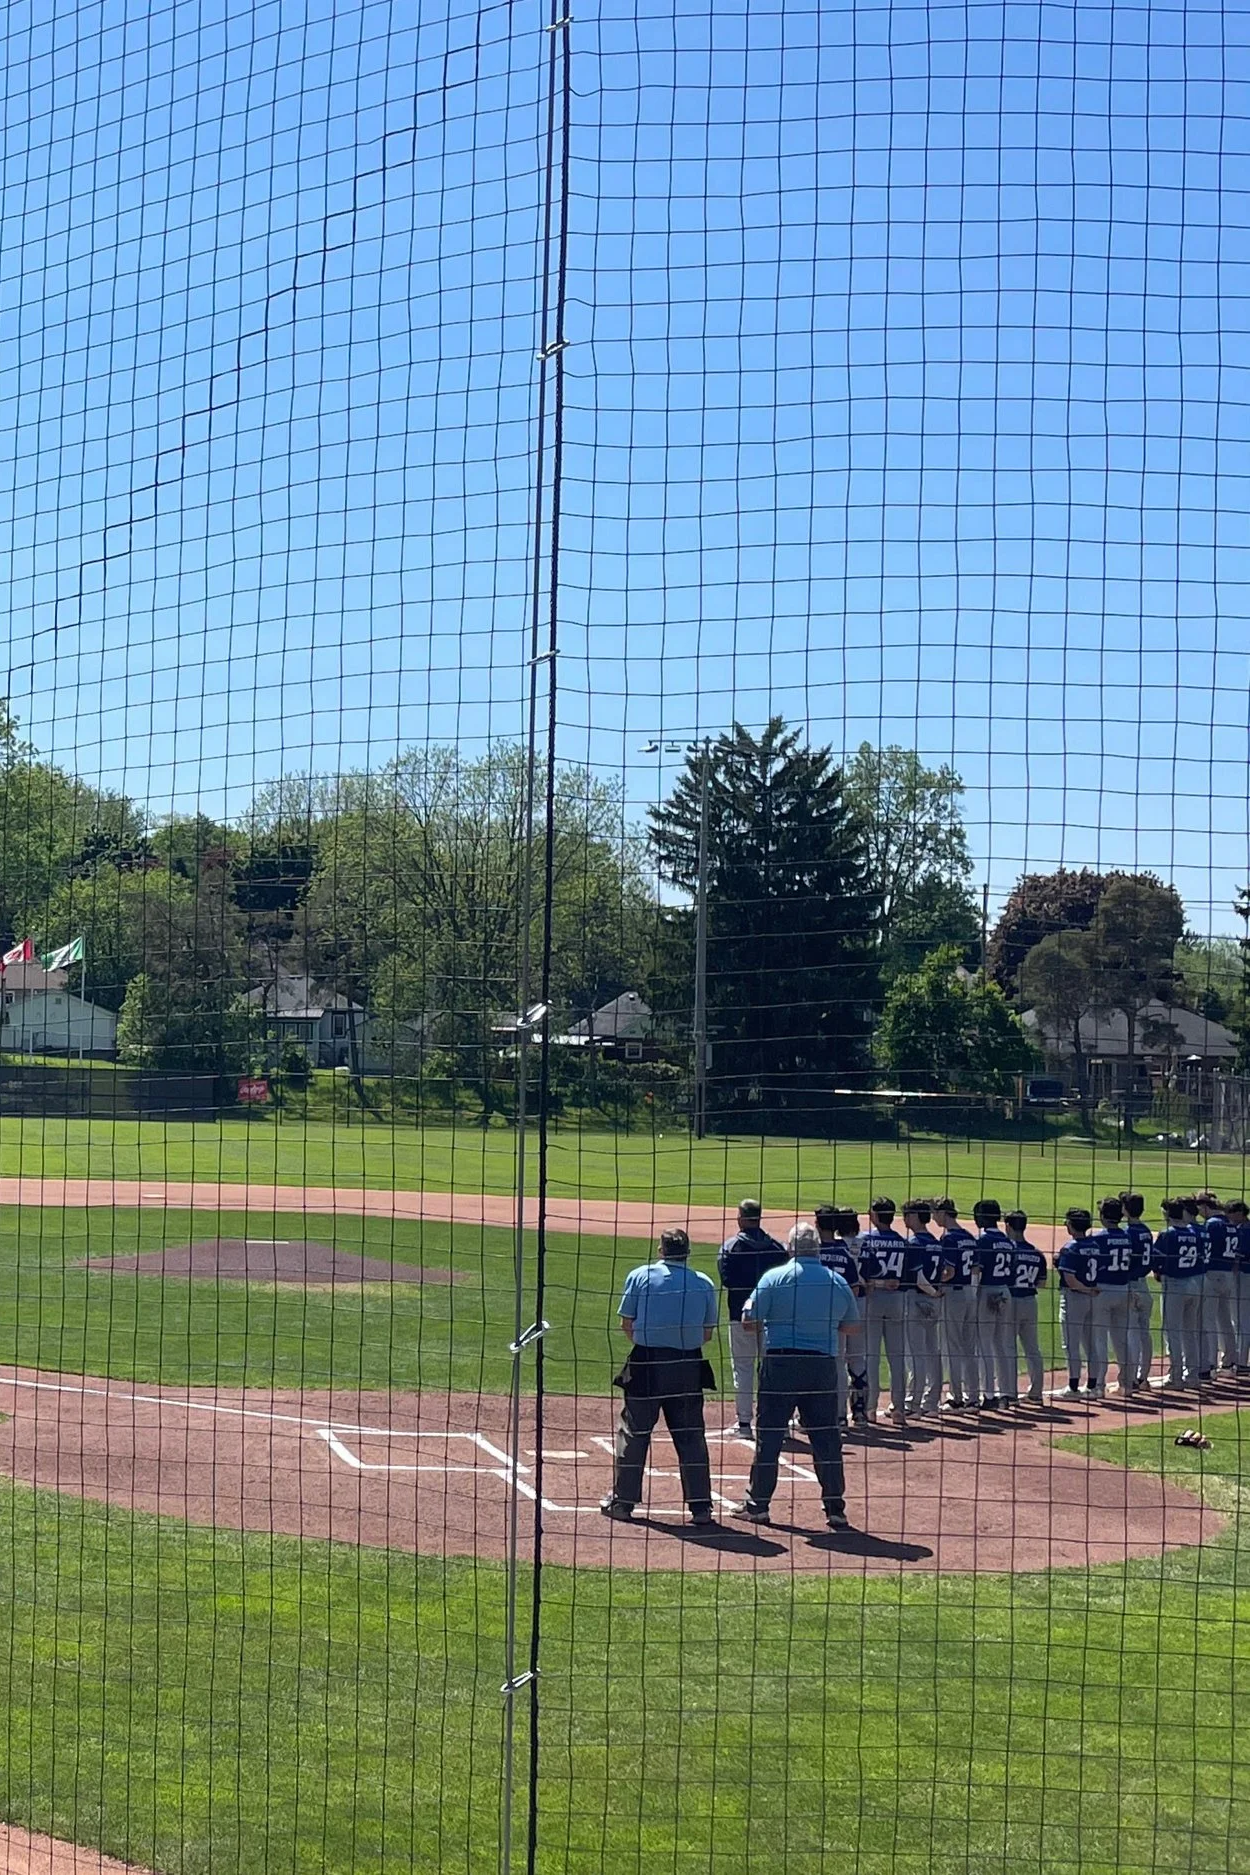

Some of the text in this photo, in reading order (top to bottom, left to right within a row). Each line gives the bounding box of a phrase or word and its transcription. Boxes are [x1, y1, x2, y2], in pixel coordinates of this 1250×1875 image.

[876, 1251, 904, 1278] 54
[1107, 1248, 1133, 1272] 15
[1178, 1246, 1197, 1268] 29
[1015, 1264, 1039, 1288] 24
